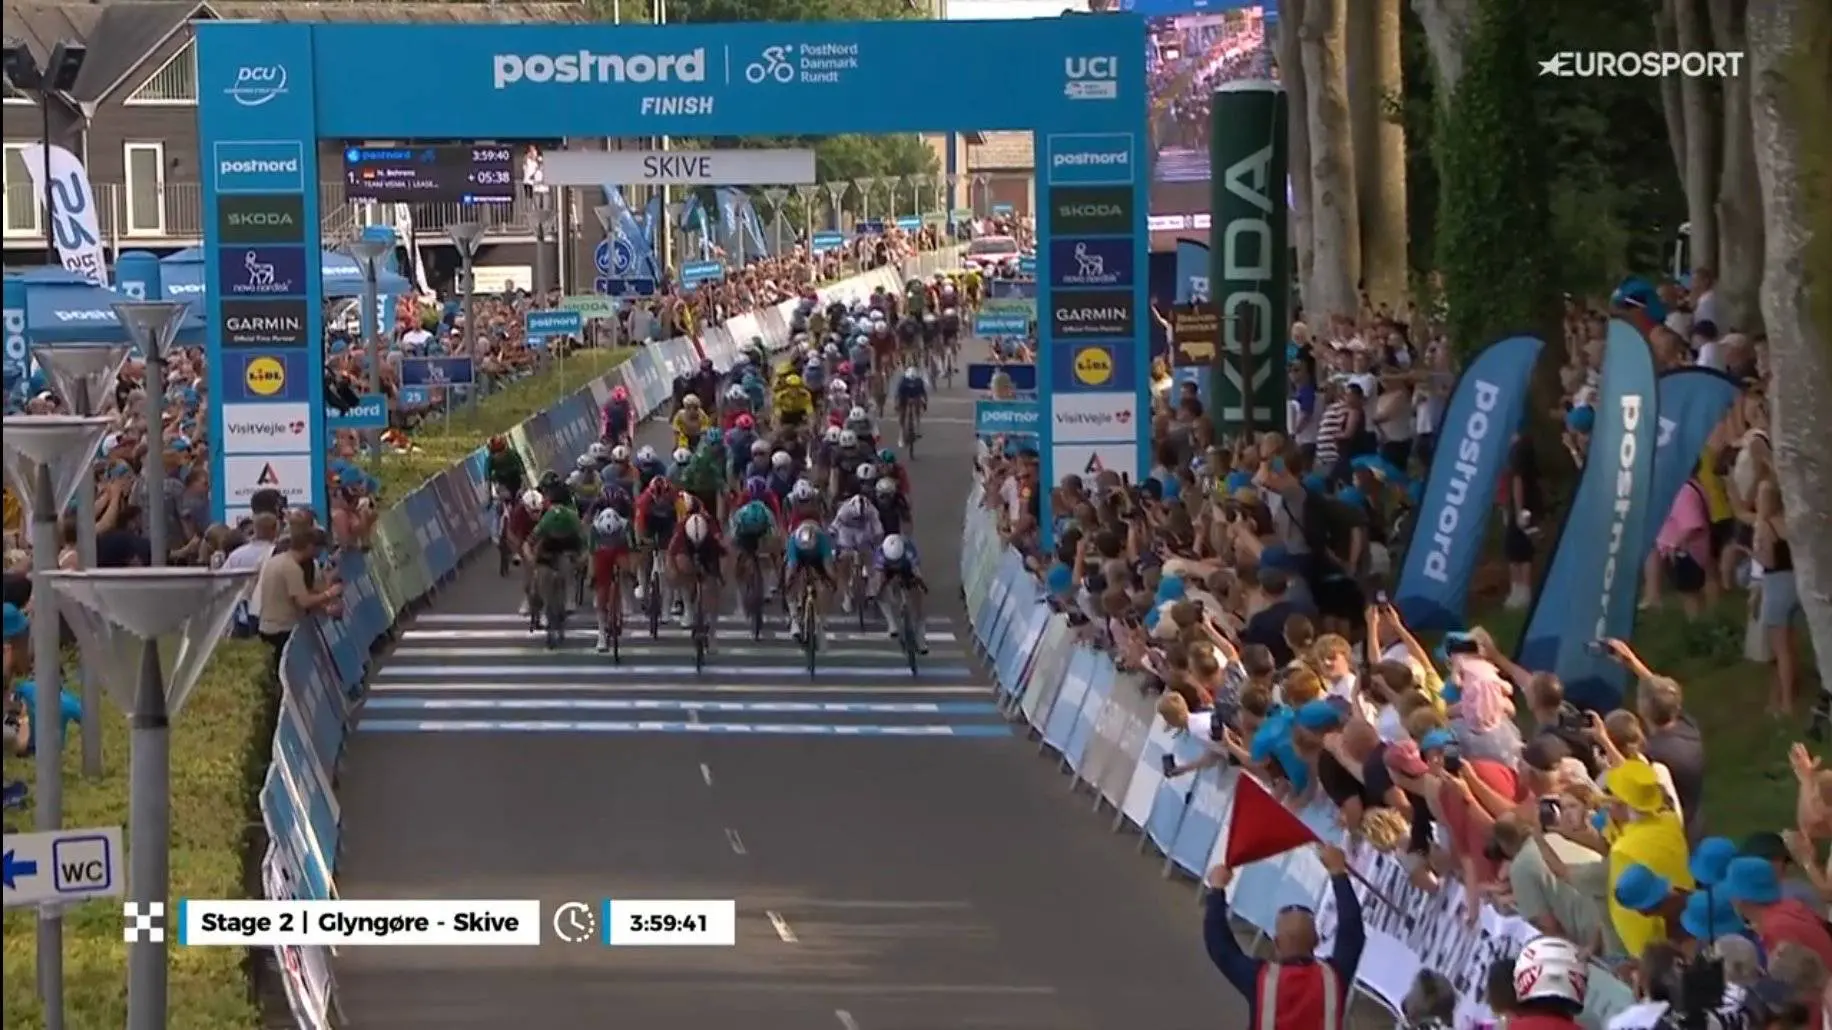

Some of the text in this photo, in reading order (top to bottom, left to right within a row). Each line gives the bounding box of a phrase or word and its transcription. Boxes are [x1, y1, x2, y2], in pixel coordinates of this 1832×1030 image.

[800, 43, 858, 55] PostNord
[494, 48, 705, 88] postnord
[800, 57, 858, 69] Danmark
[1065, 56, 1117, 78] UCI
[239, 66, 277, 80] DCU
[800, 71, 839, 82] Rundt
[641, 96, 714, 115] FINISH
[221, 158, 297, 175] postnord
[643, 155, 712, 178] SKIVE
[1054, 151, 1128, 168] postnord
[1056, 307, 1127, 321] GARMIN
[227, 317, 300, 331] GARMIN
[227, 421, 286, 437] VisitVejle
[1422, 379, 1501, 584] postnord
[61, 860, 104, 884] WC
